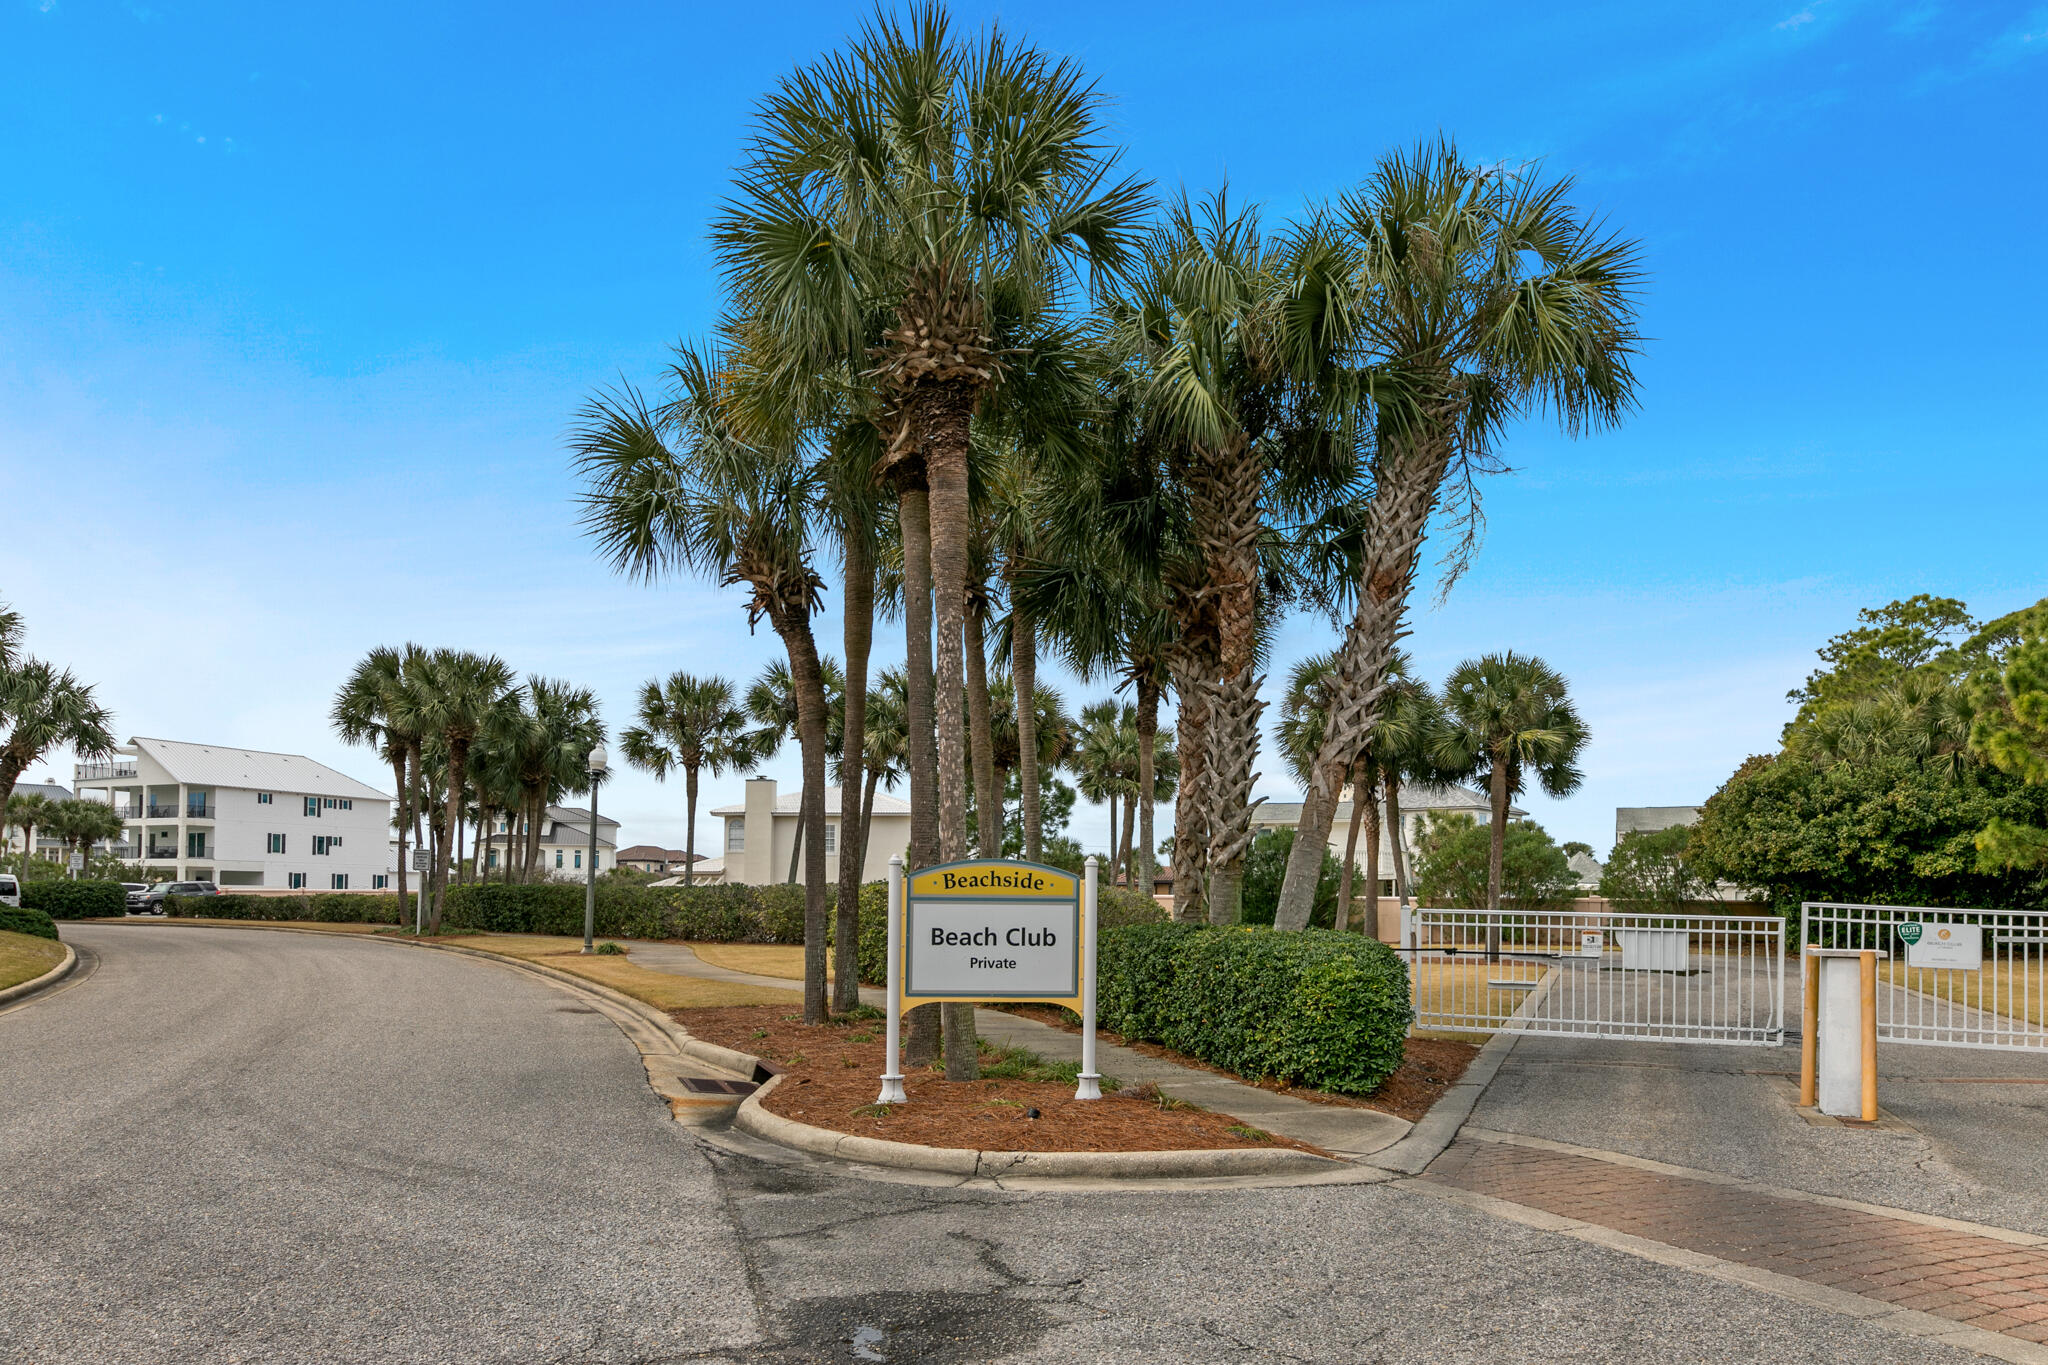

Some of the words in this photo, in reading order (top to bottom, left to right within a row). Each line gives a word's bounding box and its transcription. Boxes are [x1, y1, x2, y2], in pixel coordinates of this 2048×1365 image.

[942, 870, 1045, 891] Beachside
[931, 927, 997, 946] Beach
[1006, 927, 1057, 947] Club
[970, 957, 1017, 969] Private
